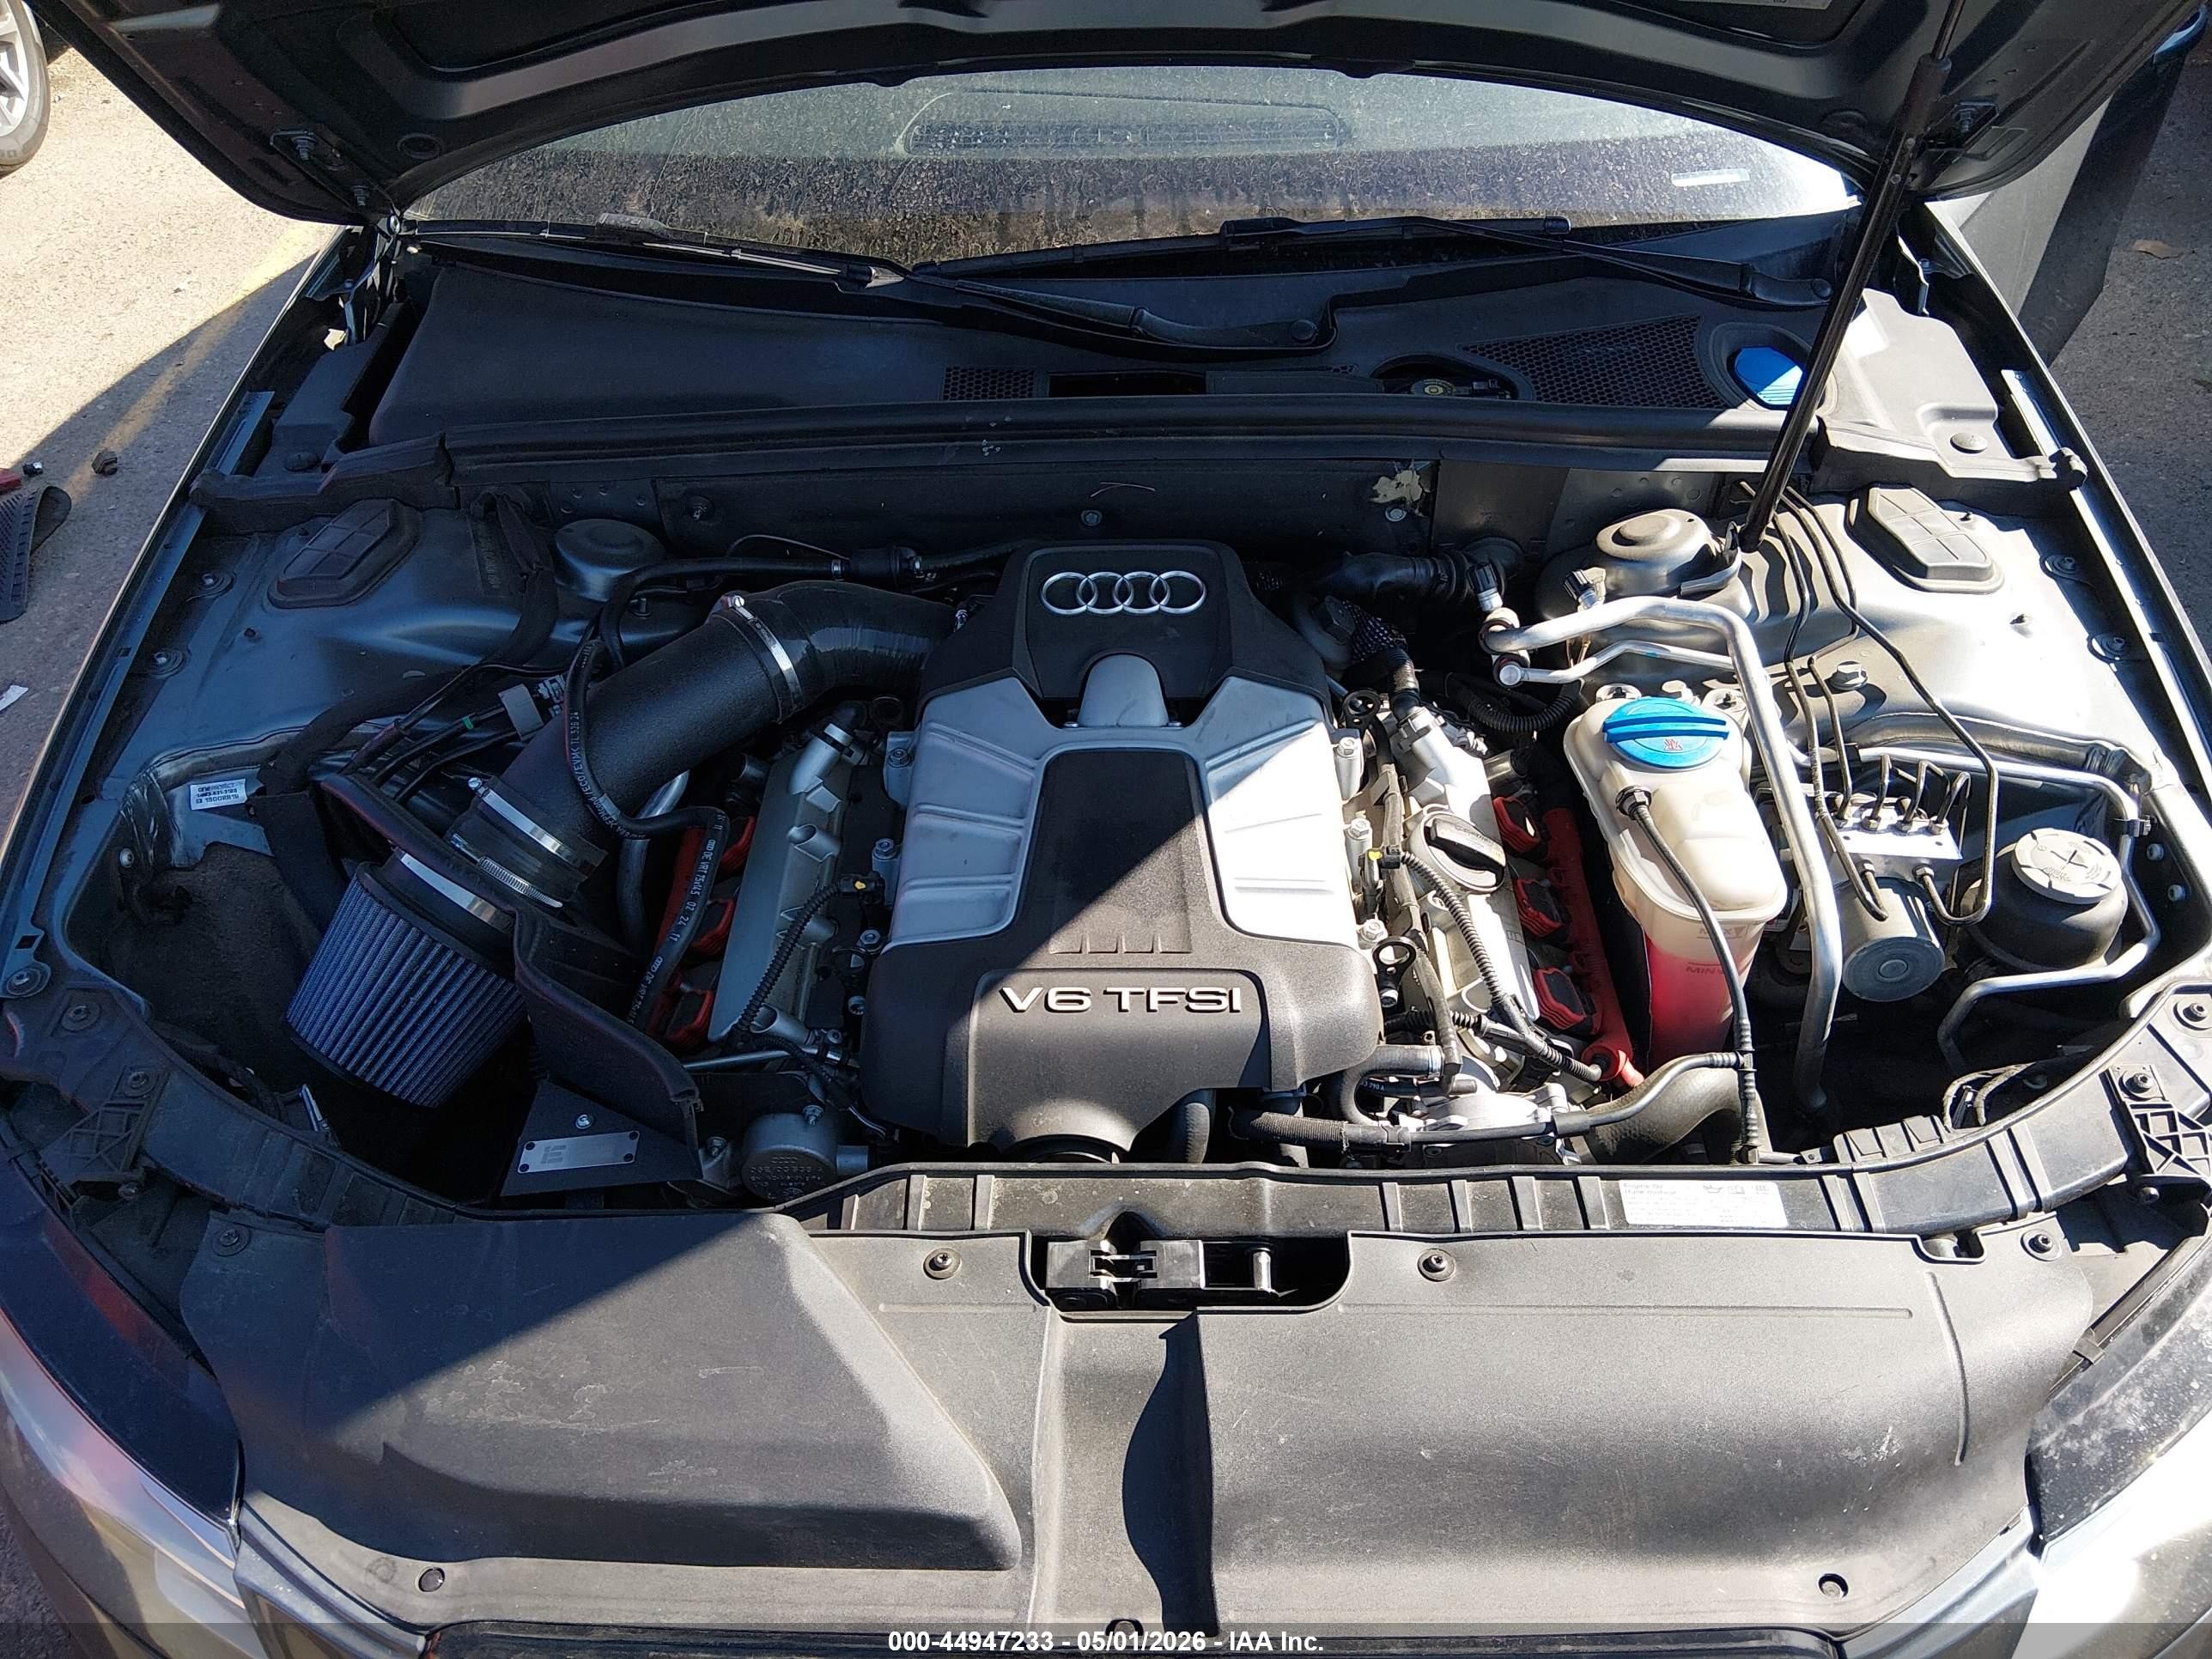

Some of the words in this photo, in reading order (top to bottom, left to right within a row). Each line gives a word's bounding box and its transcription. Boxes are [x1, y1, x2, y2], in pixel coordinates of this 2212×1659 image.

[685, 902, 697, 911] 02
[1686, 966, 1716, 975] MIN
[999, 987, 1092, 1013] V6
[1103, 987, 1242, 1013] TFSI
